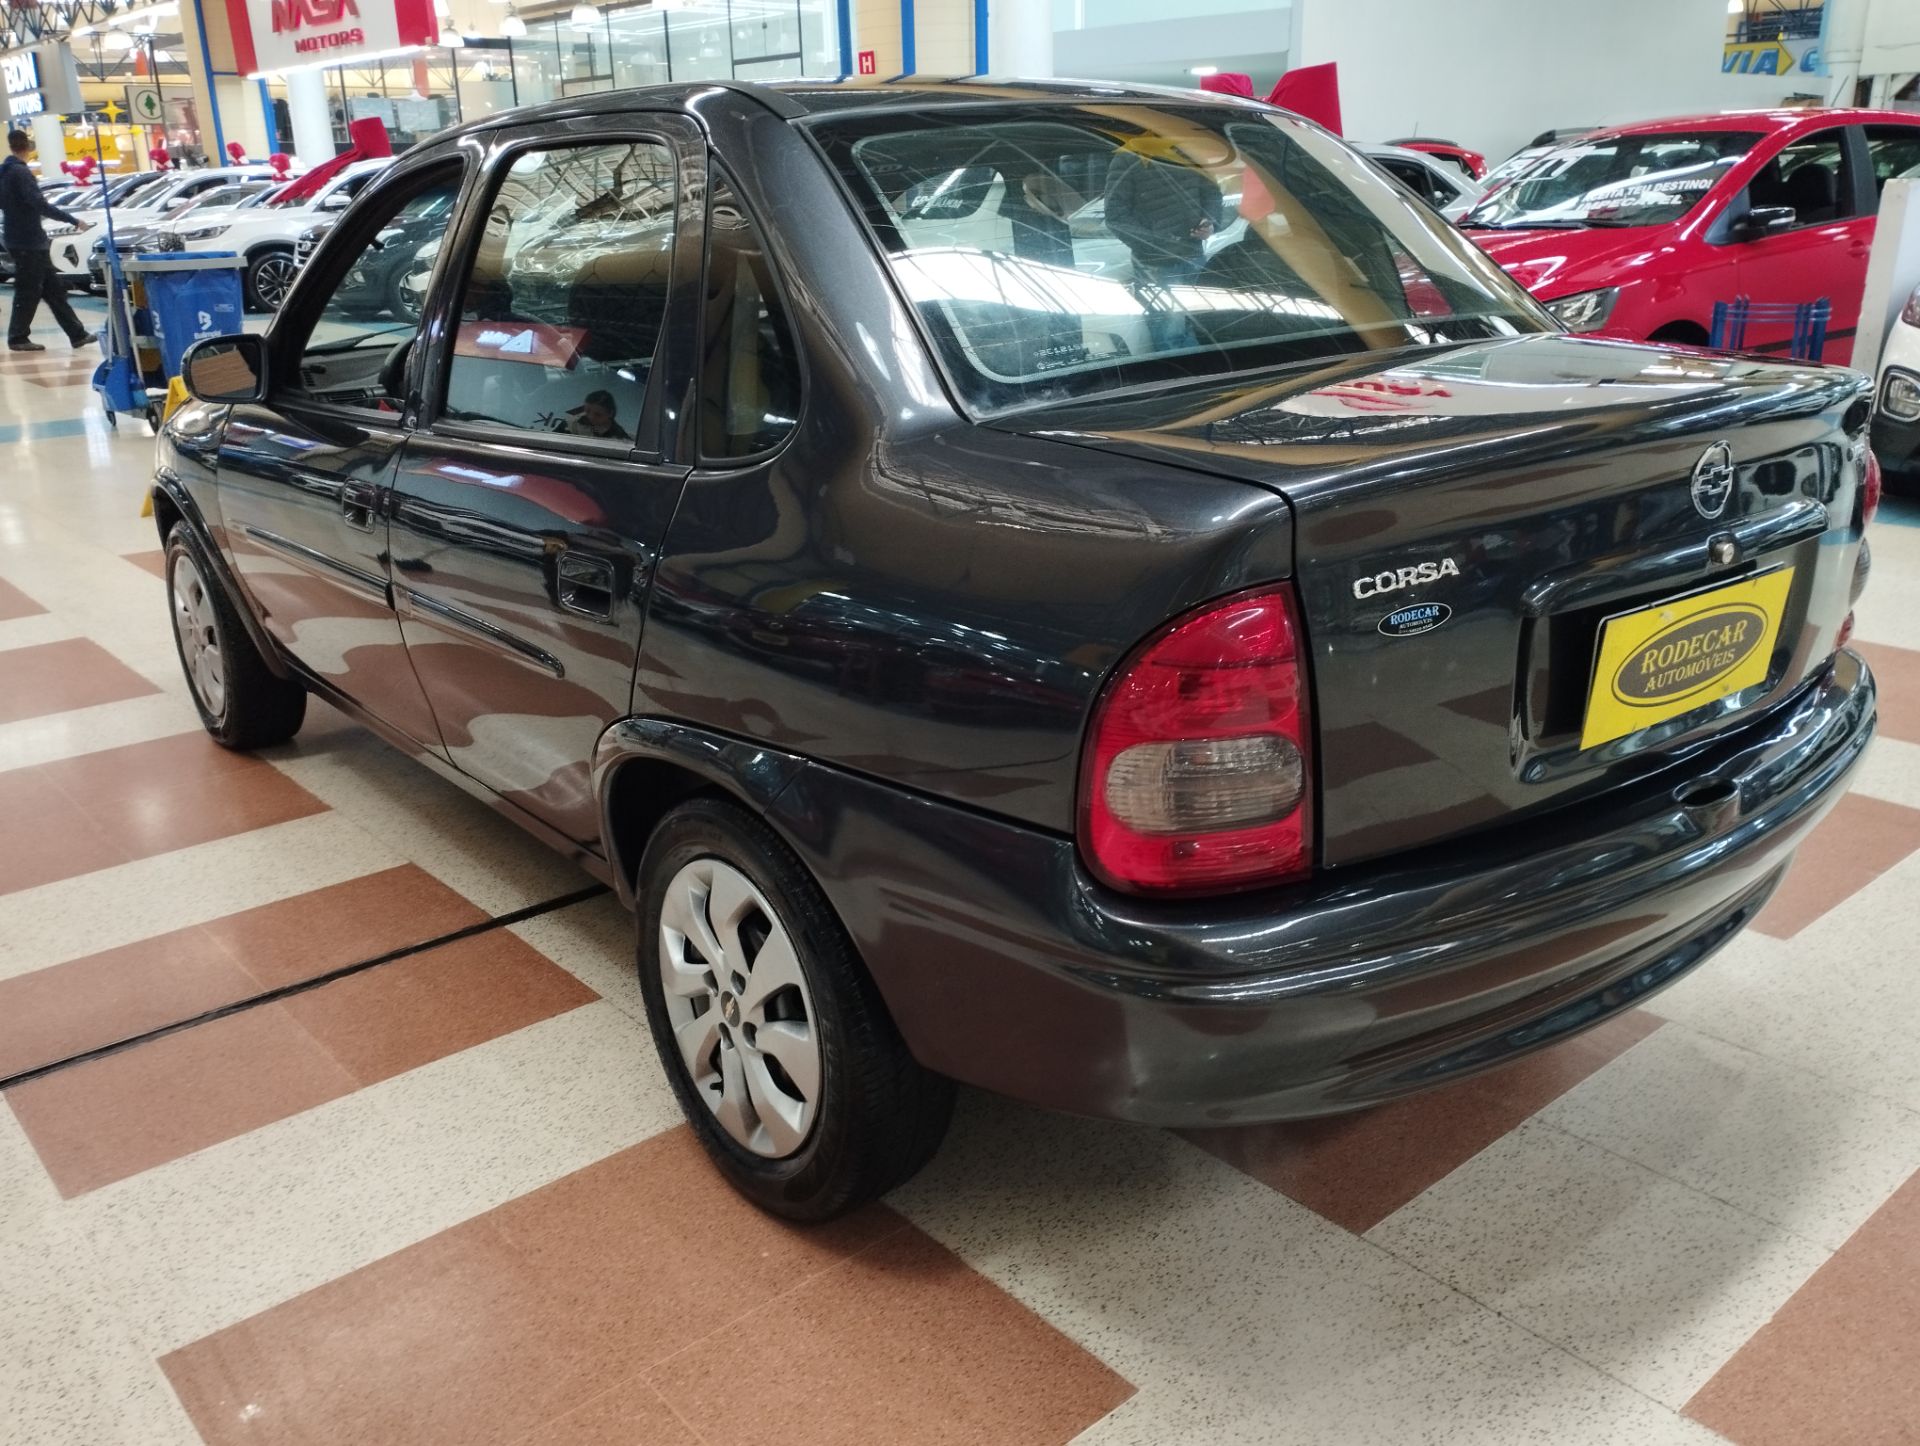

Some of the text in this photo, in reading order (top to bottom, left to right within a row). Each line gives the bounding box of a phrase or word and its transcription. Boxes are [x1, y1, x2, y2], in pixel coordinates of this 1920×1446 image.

[294, 27, 364, 54] MOTORS
[862, 55, 873, 73] H
[8, 92, 43, 116] MOTORS
[1353, 557, 1460, 599] CORSA
[1390, 605, 1440, 625] RODECAR
[1640, 619, 1748, 675] RODECAR
[1643, 648, 1736, 693] AUTOMÓVEIS
